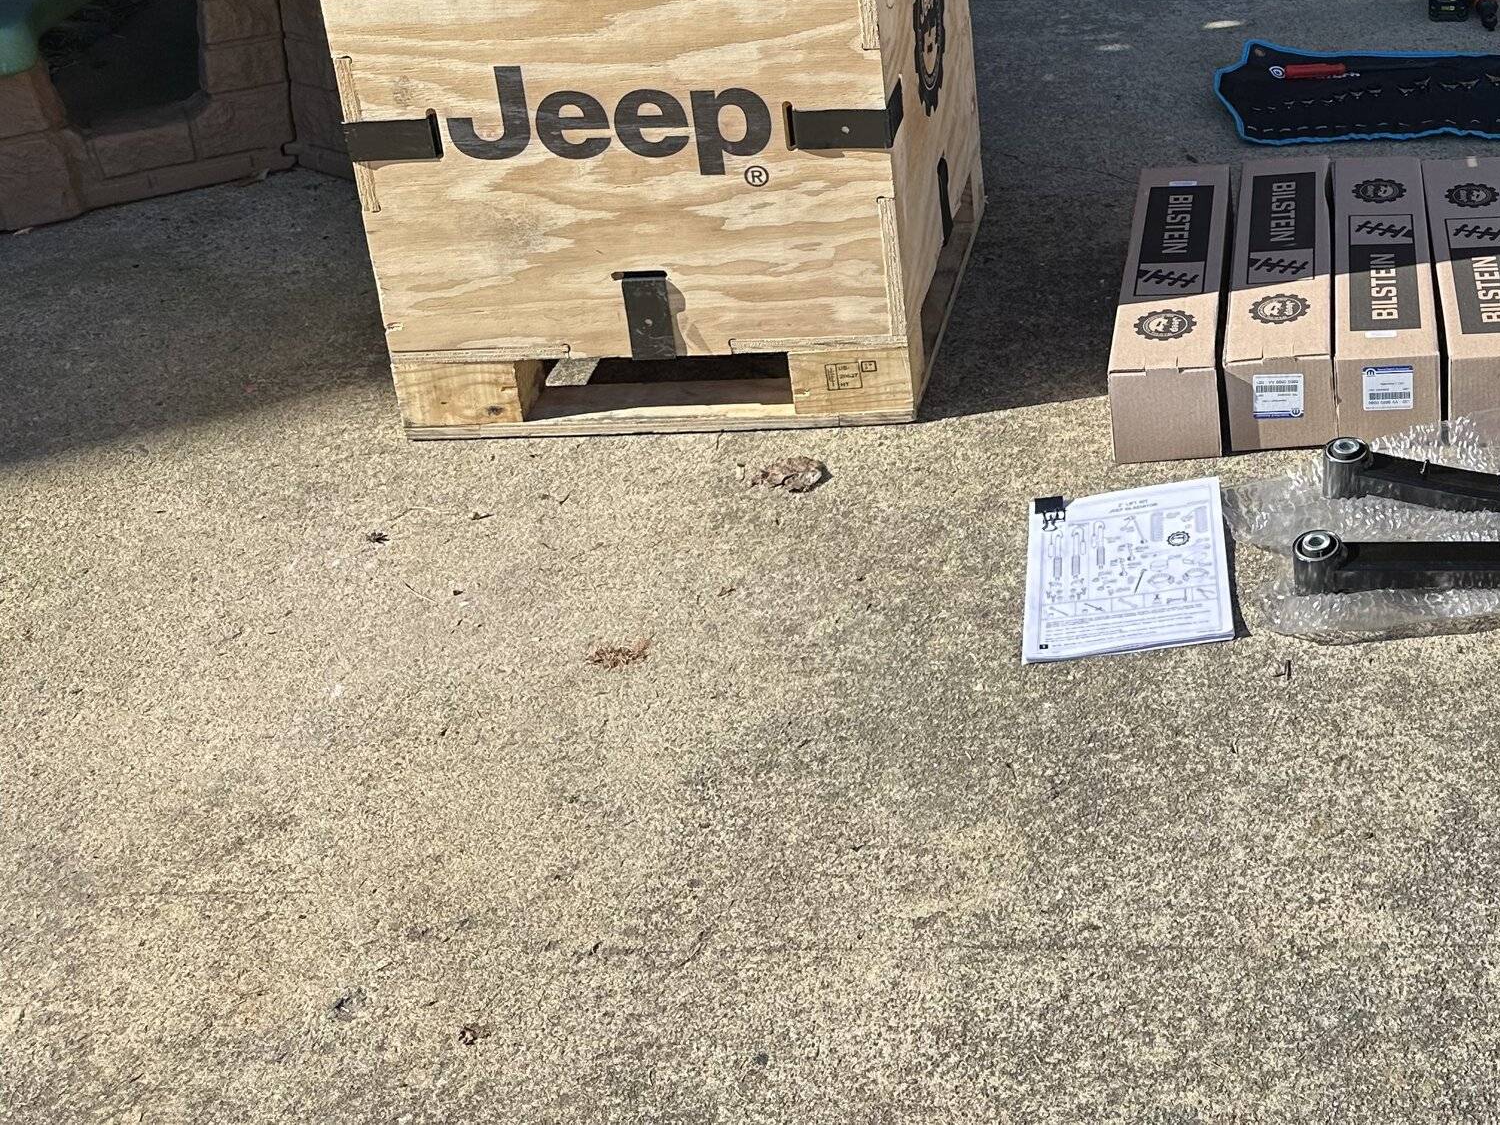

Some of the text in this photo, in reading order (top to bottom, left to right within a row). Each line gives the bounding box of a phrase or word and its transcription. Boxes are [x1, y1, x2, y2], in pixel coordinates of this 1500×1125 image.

[446, 65, 772, 176] Jeep
[1162, 194, 1193, 254] BILSTEIN
[1270, 181, 1297, 242] BILSTEIN
[1370, 253, 1399, 320] BILSTEIN
